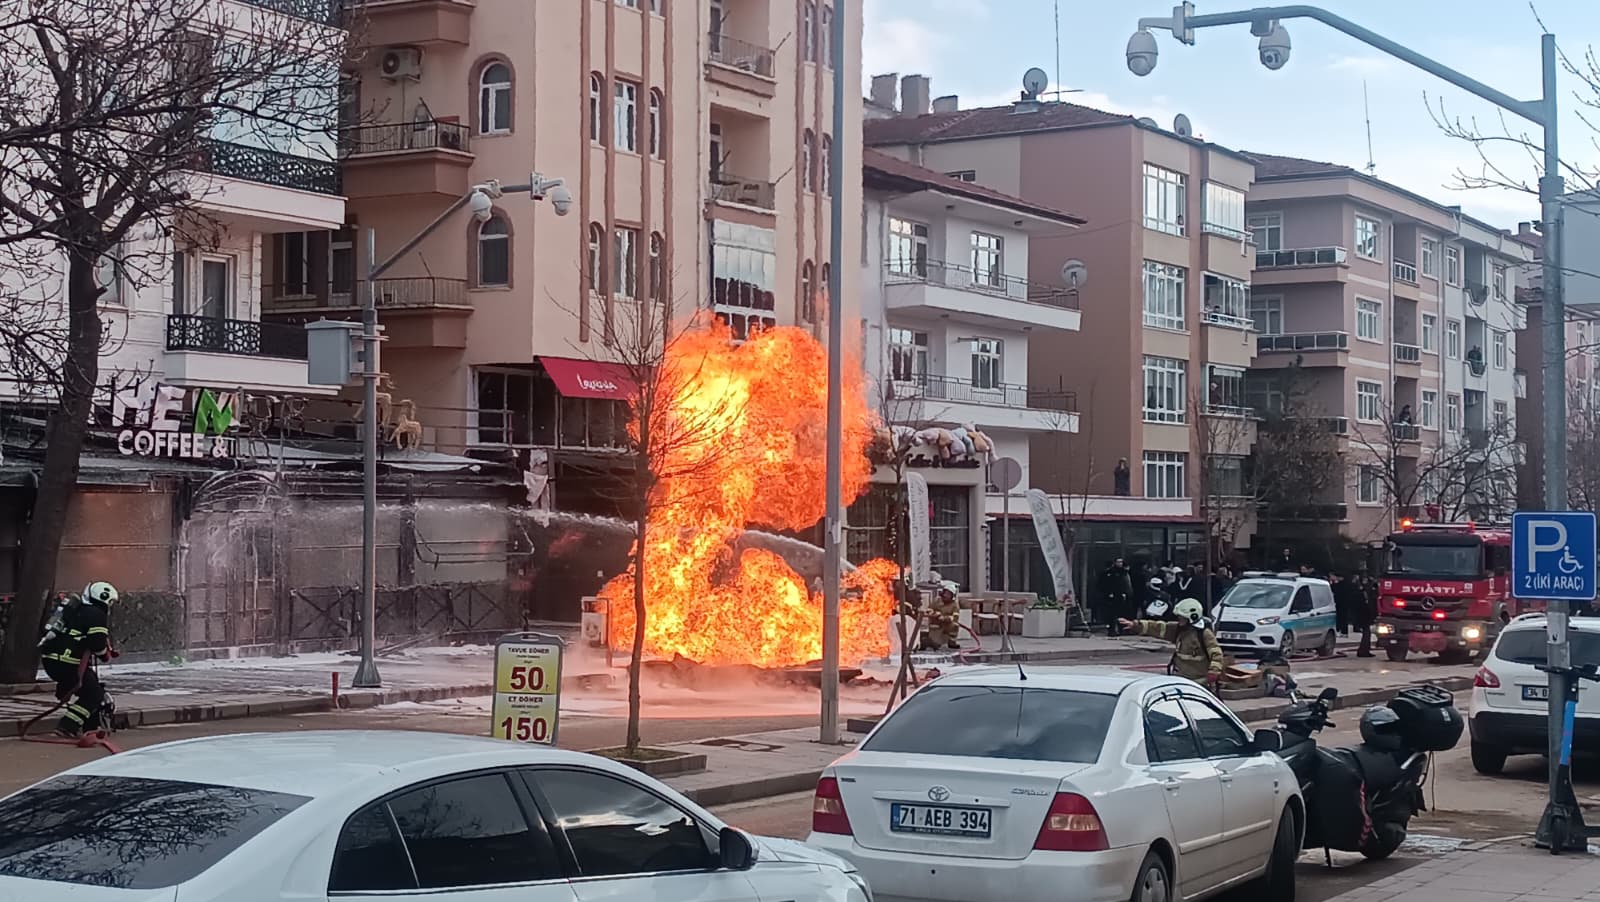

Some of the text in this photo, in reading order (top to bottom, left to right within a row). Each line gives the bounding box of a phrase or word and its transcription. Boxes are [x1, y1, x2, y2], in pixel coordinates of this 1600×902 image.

[118, 430, 204, 457] COFFEE
[212, 435, 228, 457] &
[1528, 520, 1567, 573] P
[1525, 575, 1532, 588] 2
[1553, 576, 1584, 591] ARAÇ)
[510, 667, 544, 690] 50
[502, 717, 547, 741] 150
[900, 808, 987, 830] 71 AEB 394
